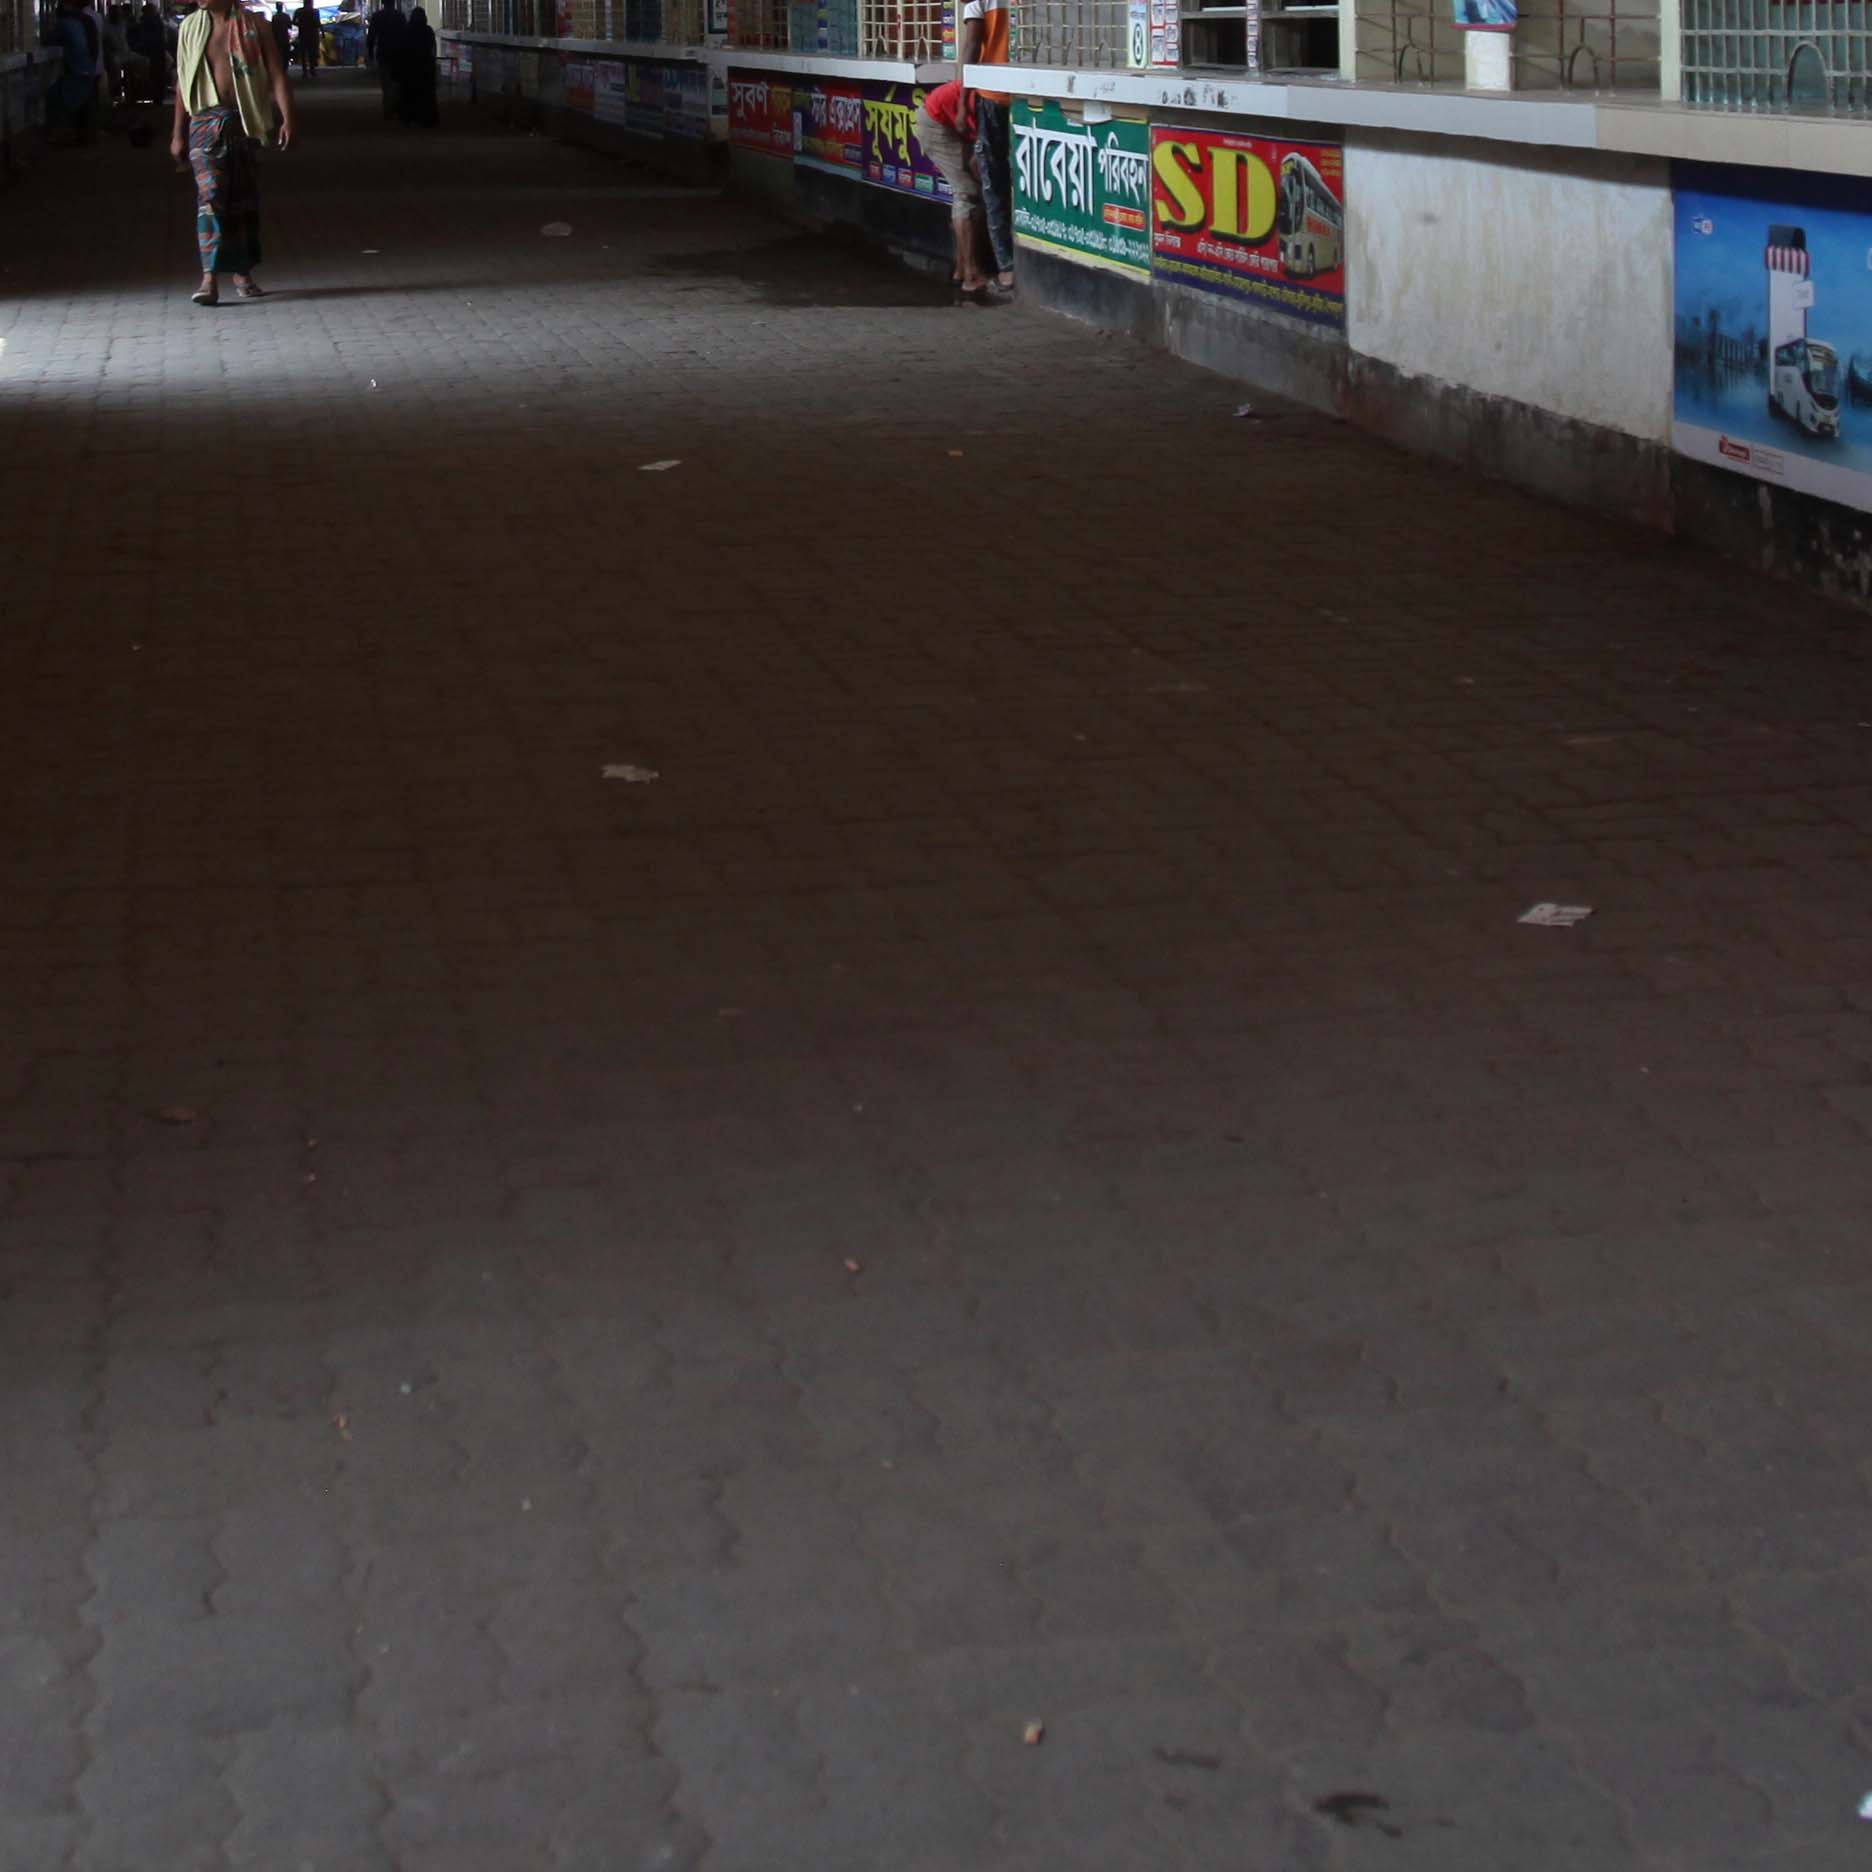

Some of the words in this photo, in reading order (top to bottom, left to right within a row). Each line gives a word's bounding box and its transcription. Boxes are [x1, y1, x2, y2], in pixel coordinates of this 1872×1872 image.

[1015, 115, 1097, 216] রাবেয়া
[1098, 131, 1149, 206] পরিবহন
[1153, 140, 1279, 245] SD
